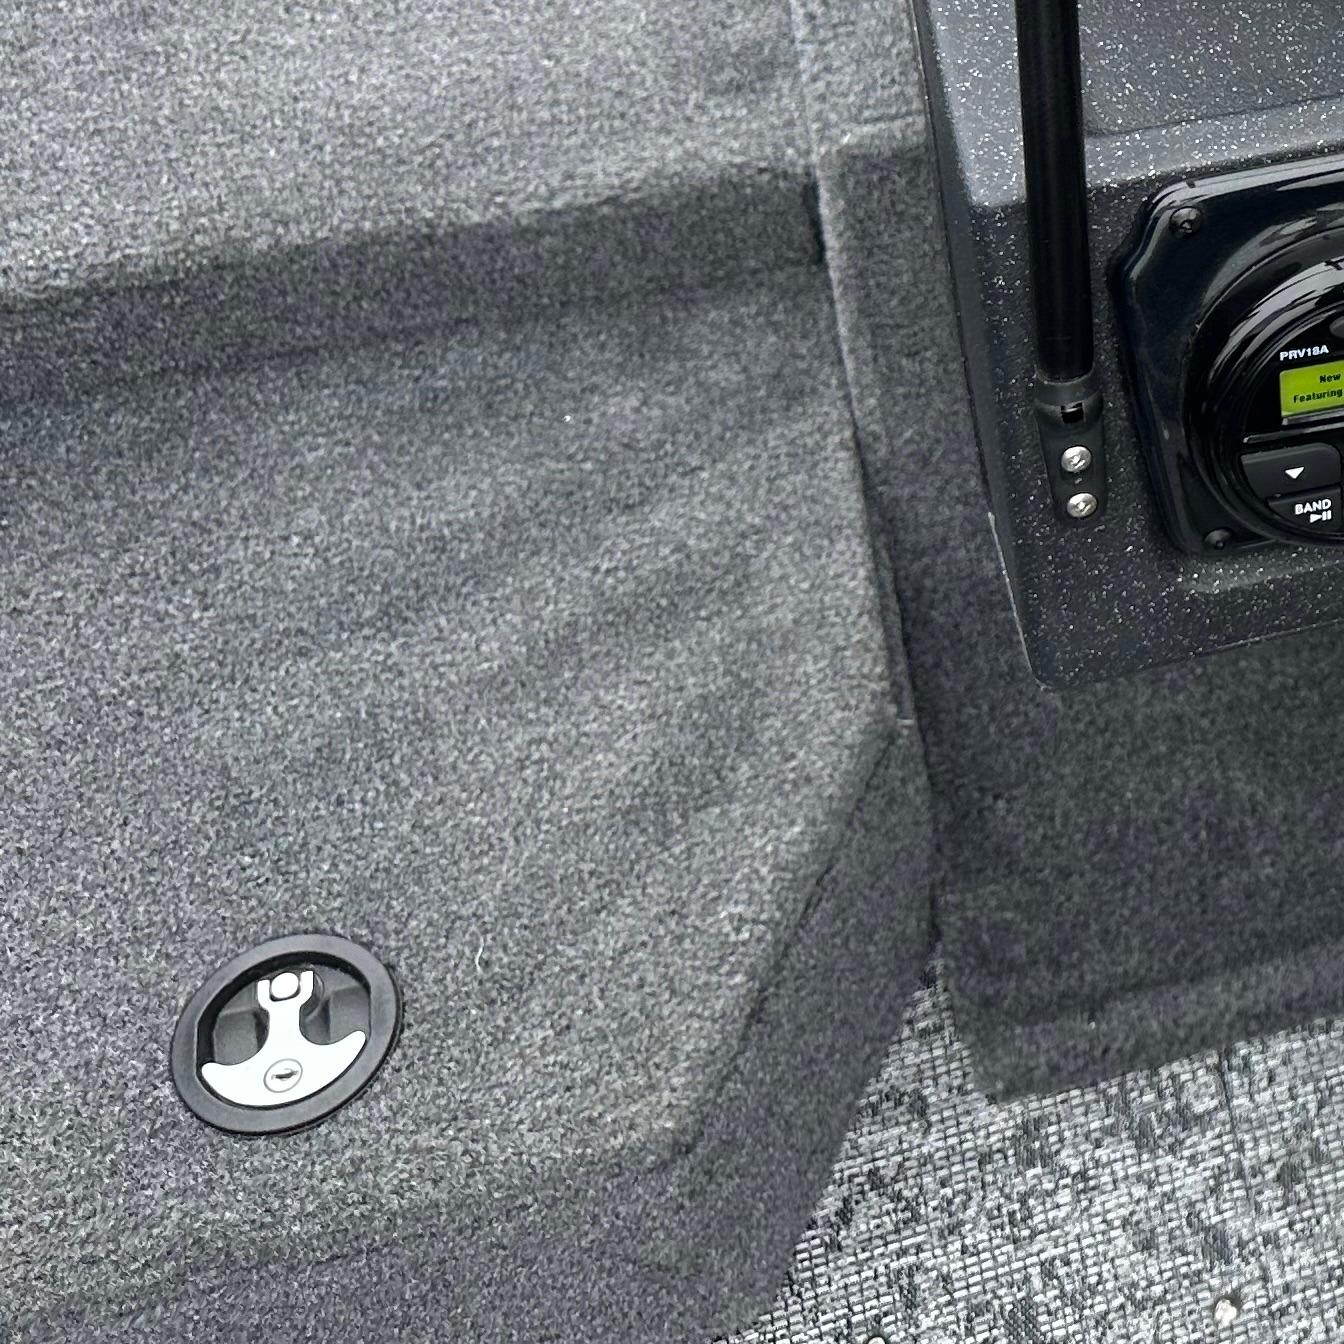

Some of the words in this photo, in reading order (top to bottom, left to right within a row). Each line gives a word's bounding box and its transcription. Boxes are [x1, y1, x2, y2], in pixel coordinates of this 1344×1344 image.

[1319, 373, 1341, 384] New
[1293, 388, 1343, 403] Featuring
[1294, 498, 1332, 515] BAND
